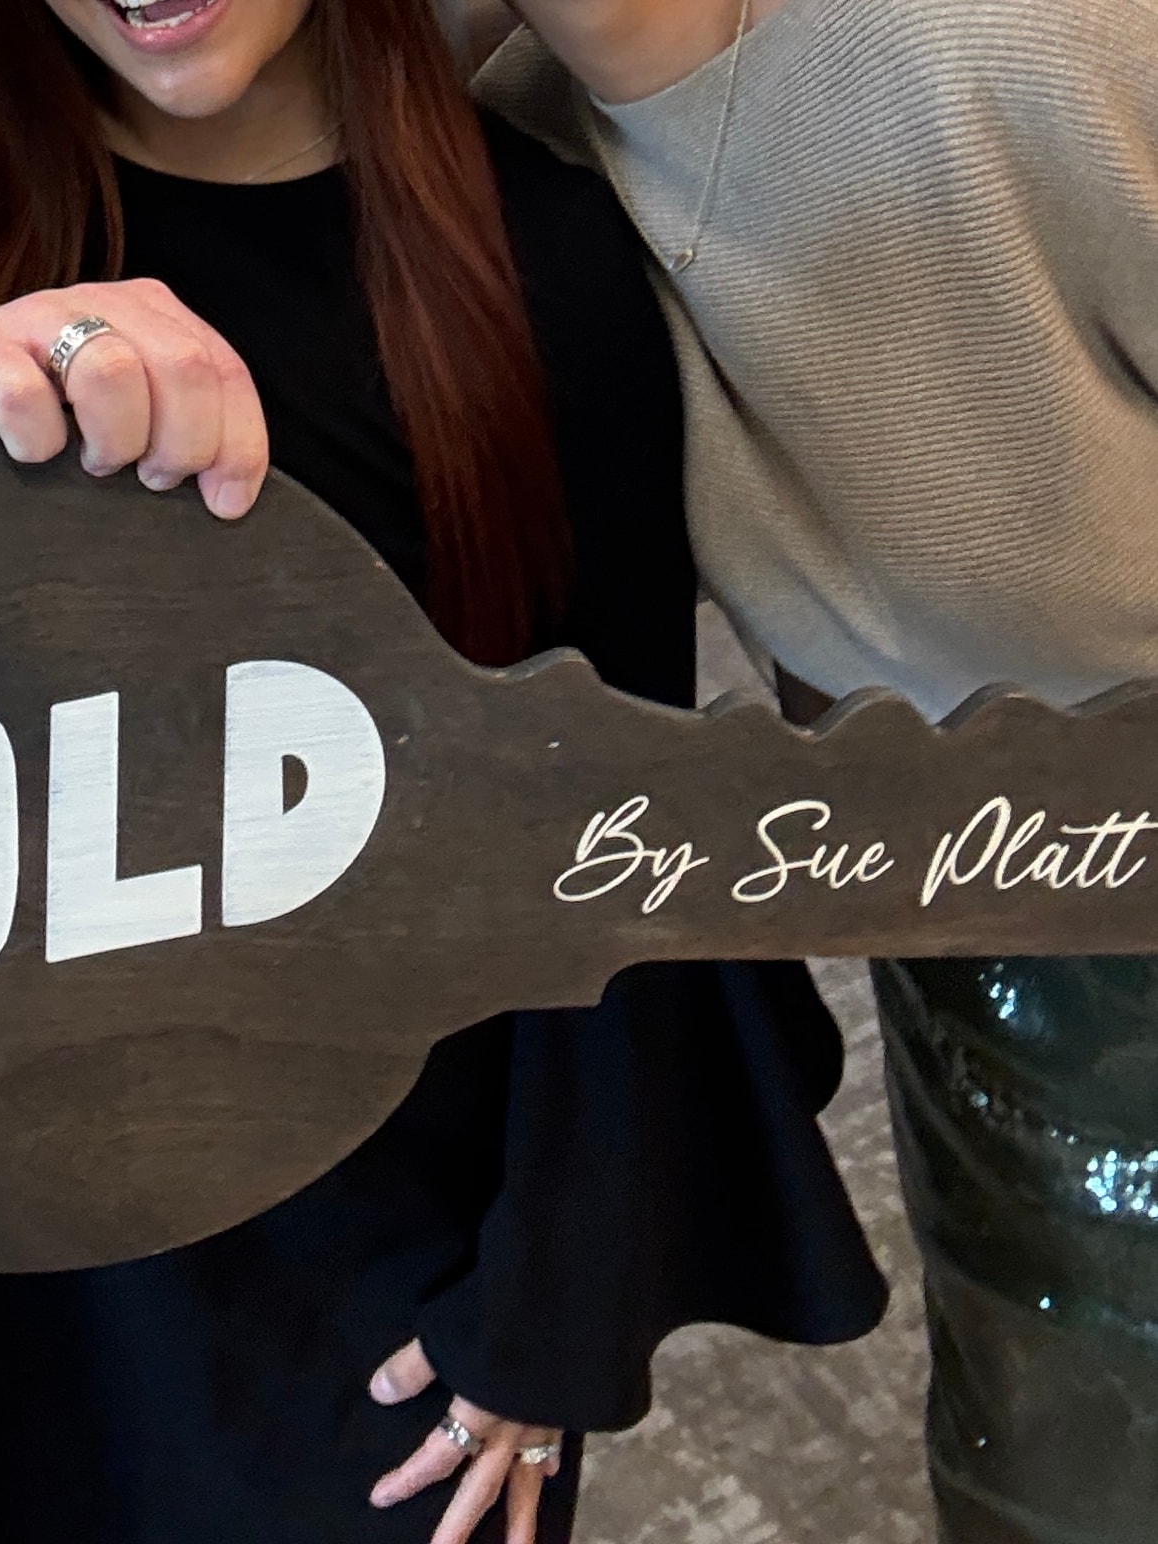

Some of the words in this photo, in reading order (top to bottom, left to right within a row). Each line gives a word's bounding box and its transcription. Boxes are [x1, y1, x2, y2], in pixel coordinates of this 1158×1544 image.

[553, 795, 710, 915] By
[730, 799, 894, 903] Sue
[921, 796, 1158, 907] Platt
